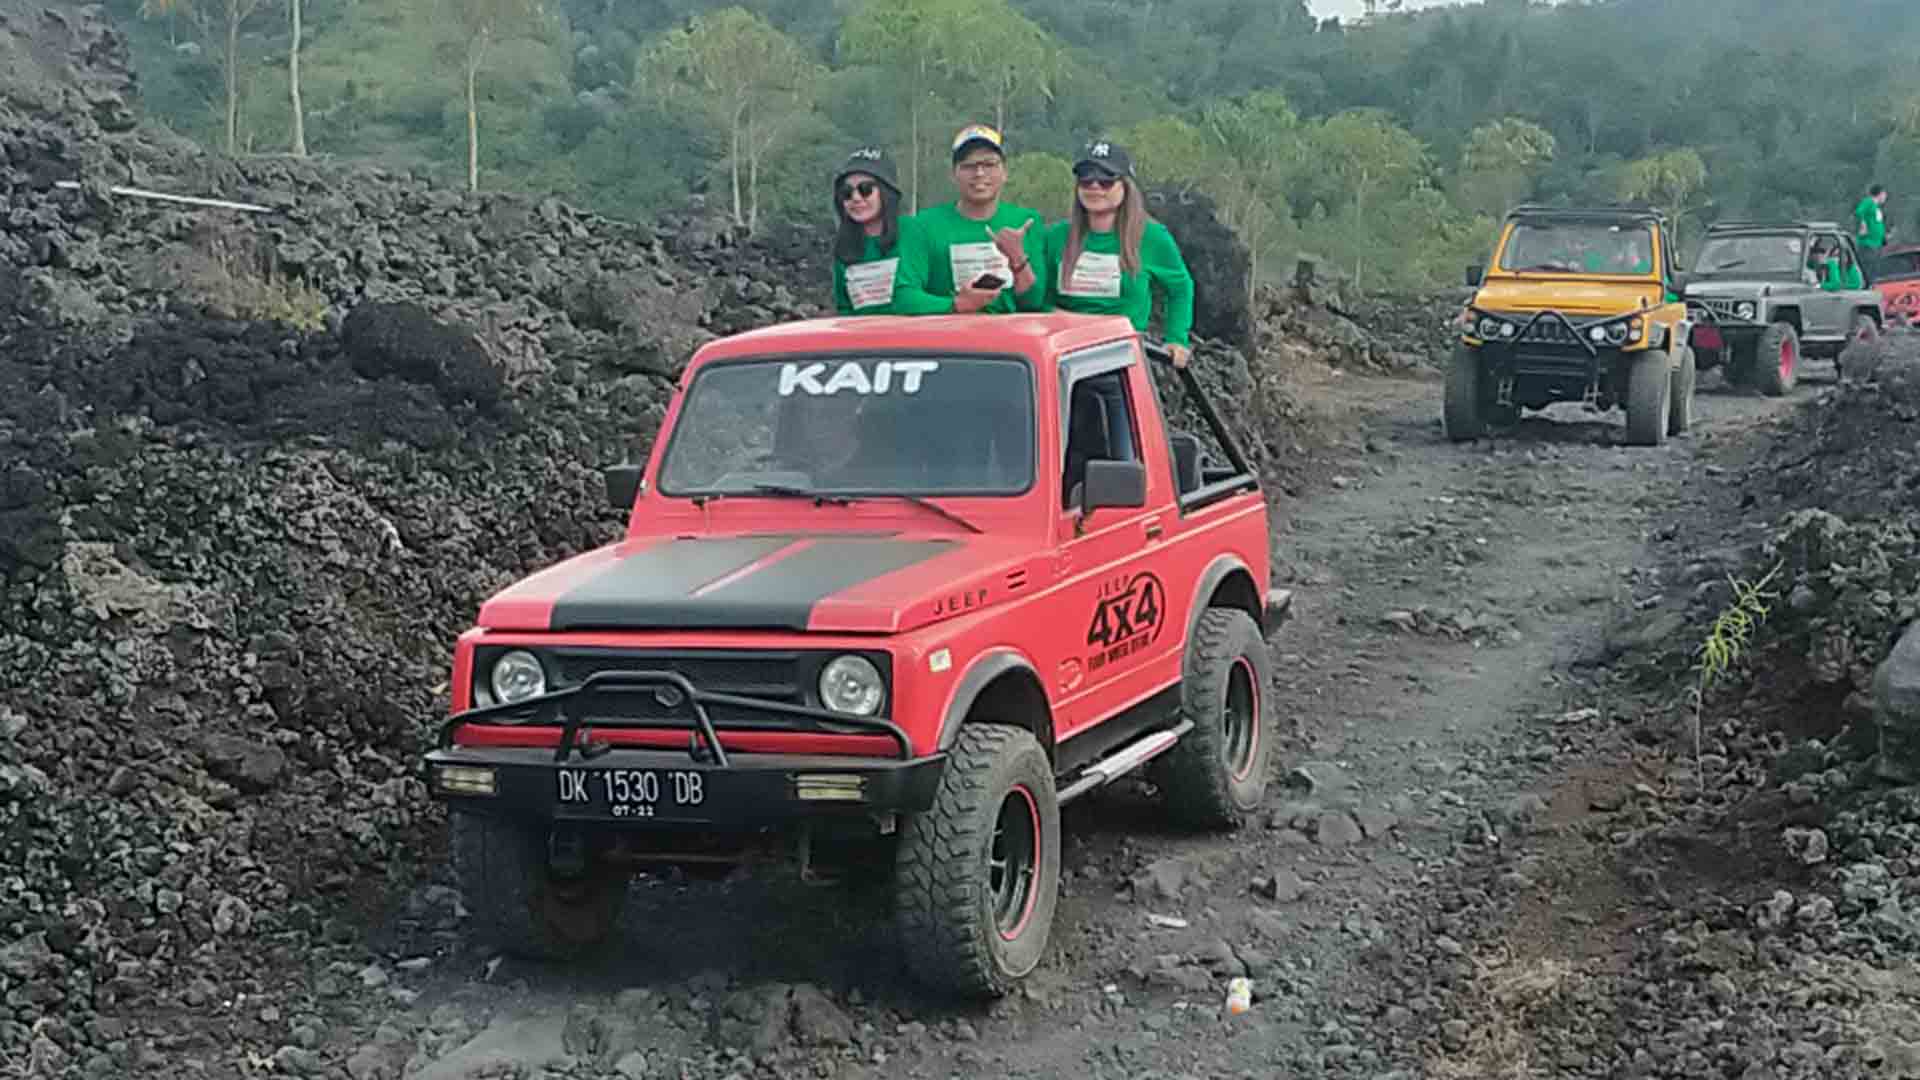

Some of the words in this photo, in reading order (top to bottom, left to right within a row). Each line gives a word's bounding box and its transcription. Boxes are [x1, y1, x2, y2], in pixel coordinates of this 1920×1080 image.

[778, 360, 939, 396] KAIT
[934, 589, 988, 616] JEEP
[558, 770, 589, 801] DK
[603, 770, 659, 802] 1530
[675, 771, 704, 804] DB
